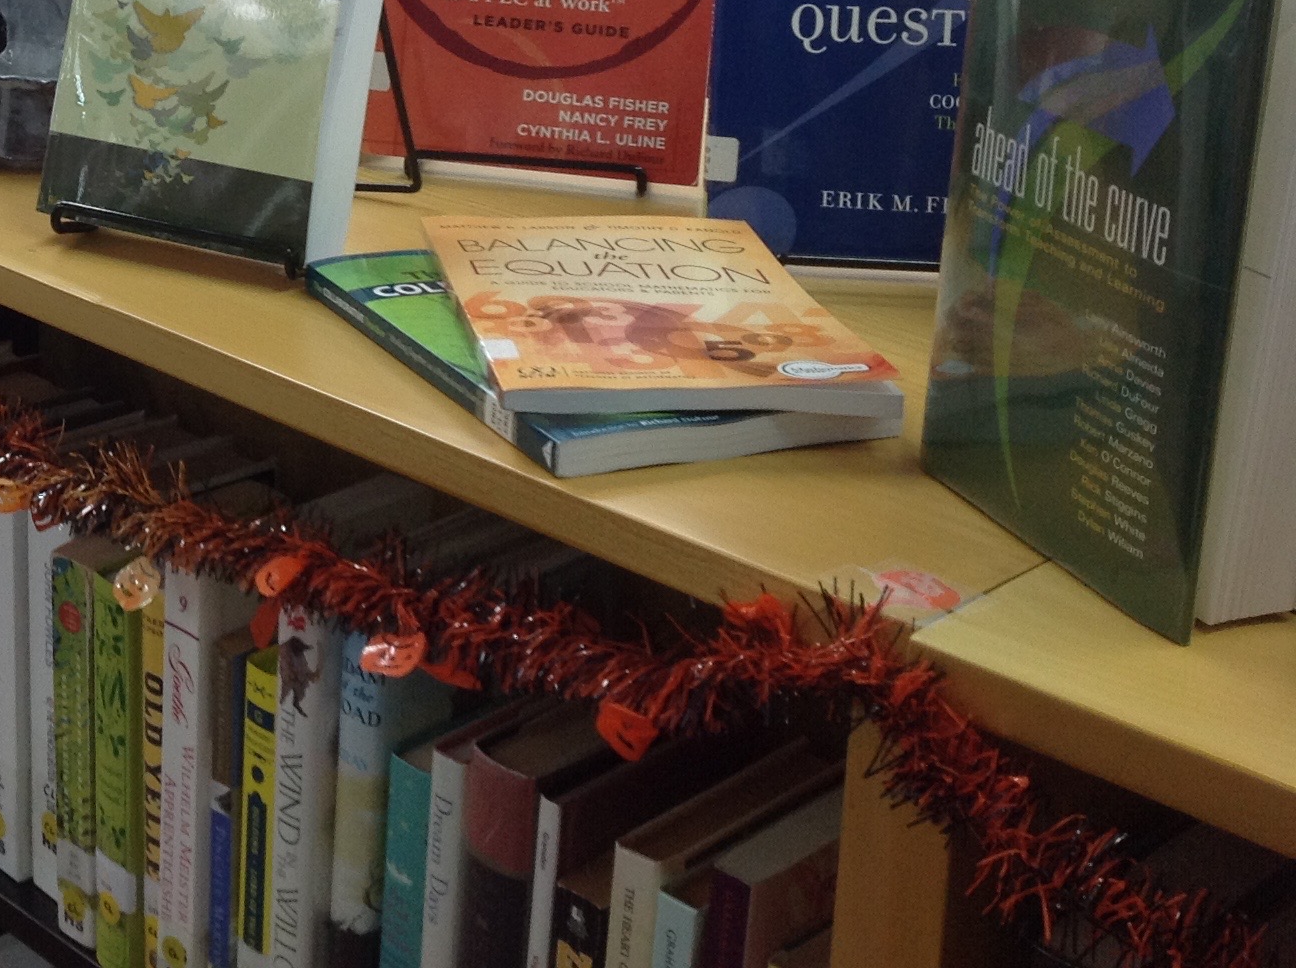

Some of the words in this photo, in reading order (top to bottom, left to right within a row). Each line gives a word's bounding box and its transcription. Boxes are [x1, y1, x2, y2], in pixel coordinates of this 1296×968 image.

[473, 13, 565, 34] LEADER'S
[571, 19, 631, 39] GUIDE
[523, 89, 604, 108] DOUGLAS
[608, 96, 670, 115] FISHER
[558, 110, 618, 126] NANCY
[623, 116, 669, 132] FREY
[516, 123, 592, 144] CYNTHIA
[597, 132, 611, 145] L.
[615, 133, 666, 150] ULINE
[970, 106, 1032, 198] ahead
[1034, 133, 1061, 213] of
[1062, 145, 1099, 232] the
[1104, 185, 1171, 267] curve
[819, 190, 884, 212] ERIK
[891, 194, 920, 214] M.
[456, 236, 747, 255] BALANCING
[593, 250, 630, 263] the
[468, 258, 772, 286] EQUATION
[1124, 263, 1138, 278] to
[1106, 271, 1165, 313] Learning
[1121, 385, 1160, 414] DuFour
[1124, 406, 1158, 435] Gregg
[1108, 435, 1154, 470] Marzano
[1110, 474, 1150, 506] Reeves
[1113, 512, 1146, 542] White
[144, 670, 164, 750] OLD
[279, 708, 298, 746] THE
[276, 751, 304, 853] WIND
[431, 792, 453, 866] Dream
[428, 873, 450, 927] Days
[274, 887, 300, 968] WILL
